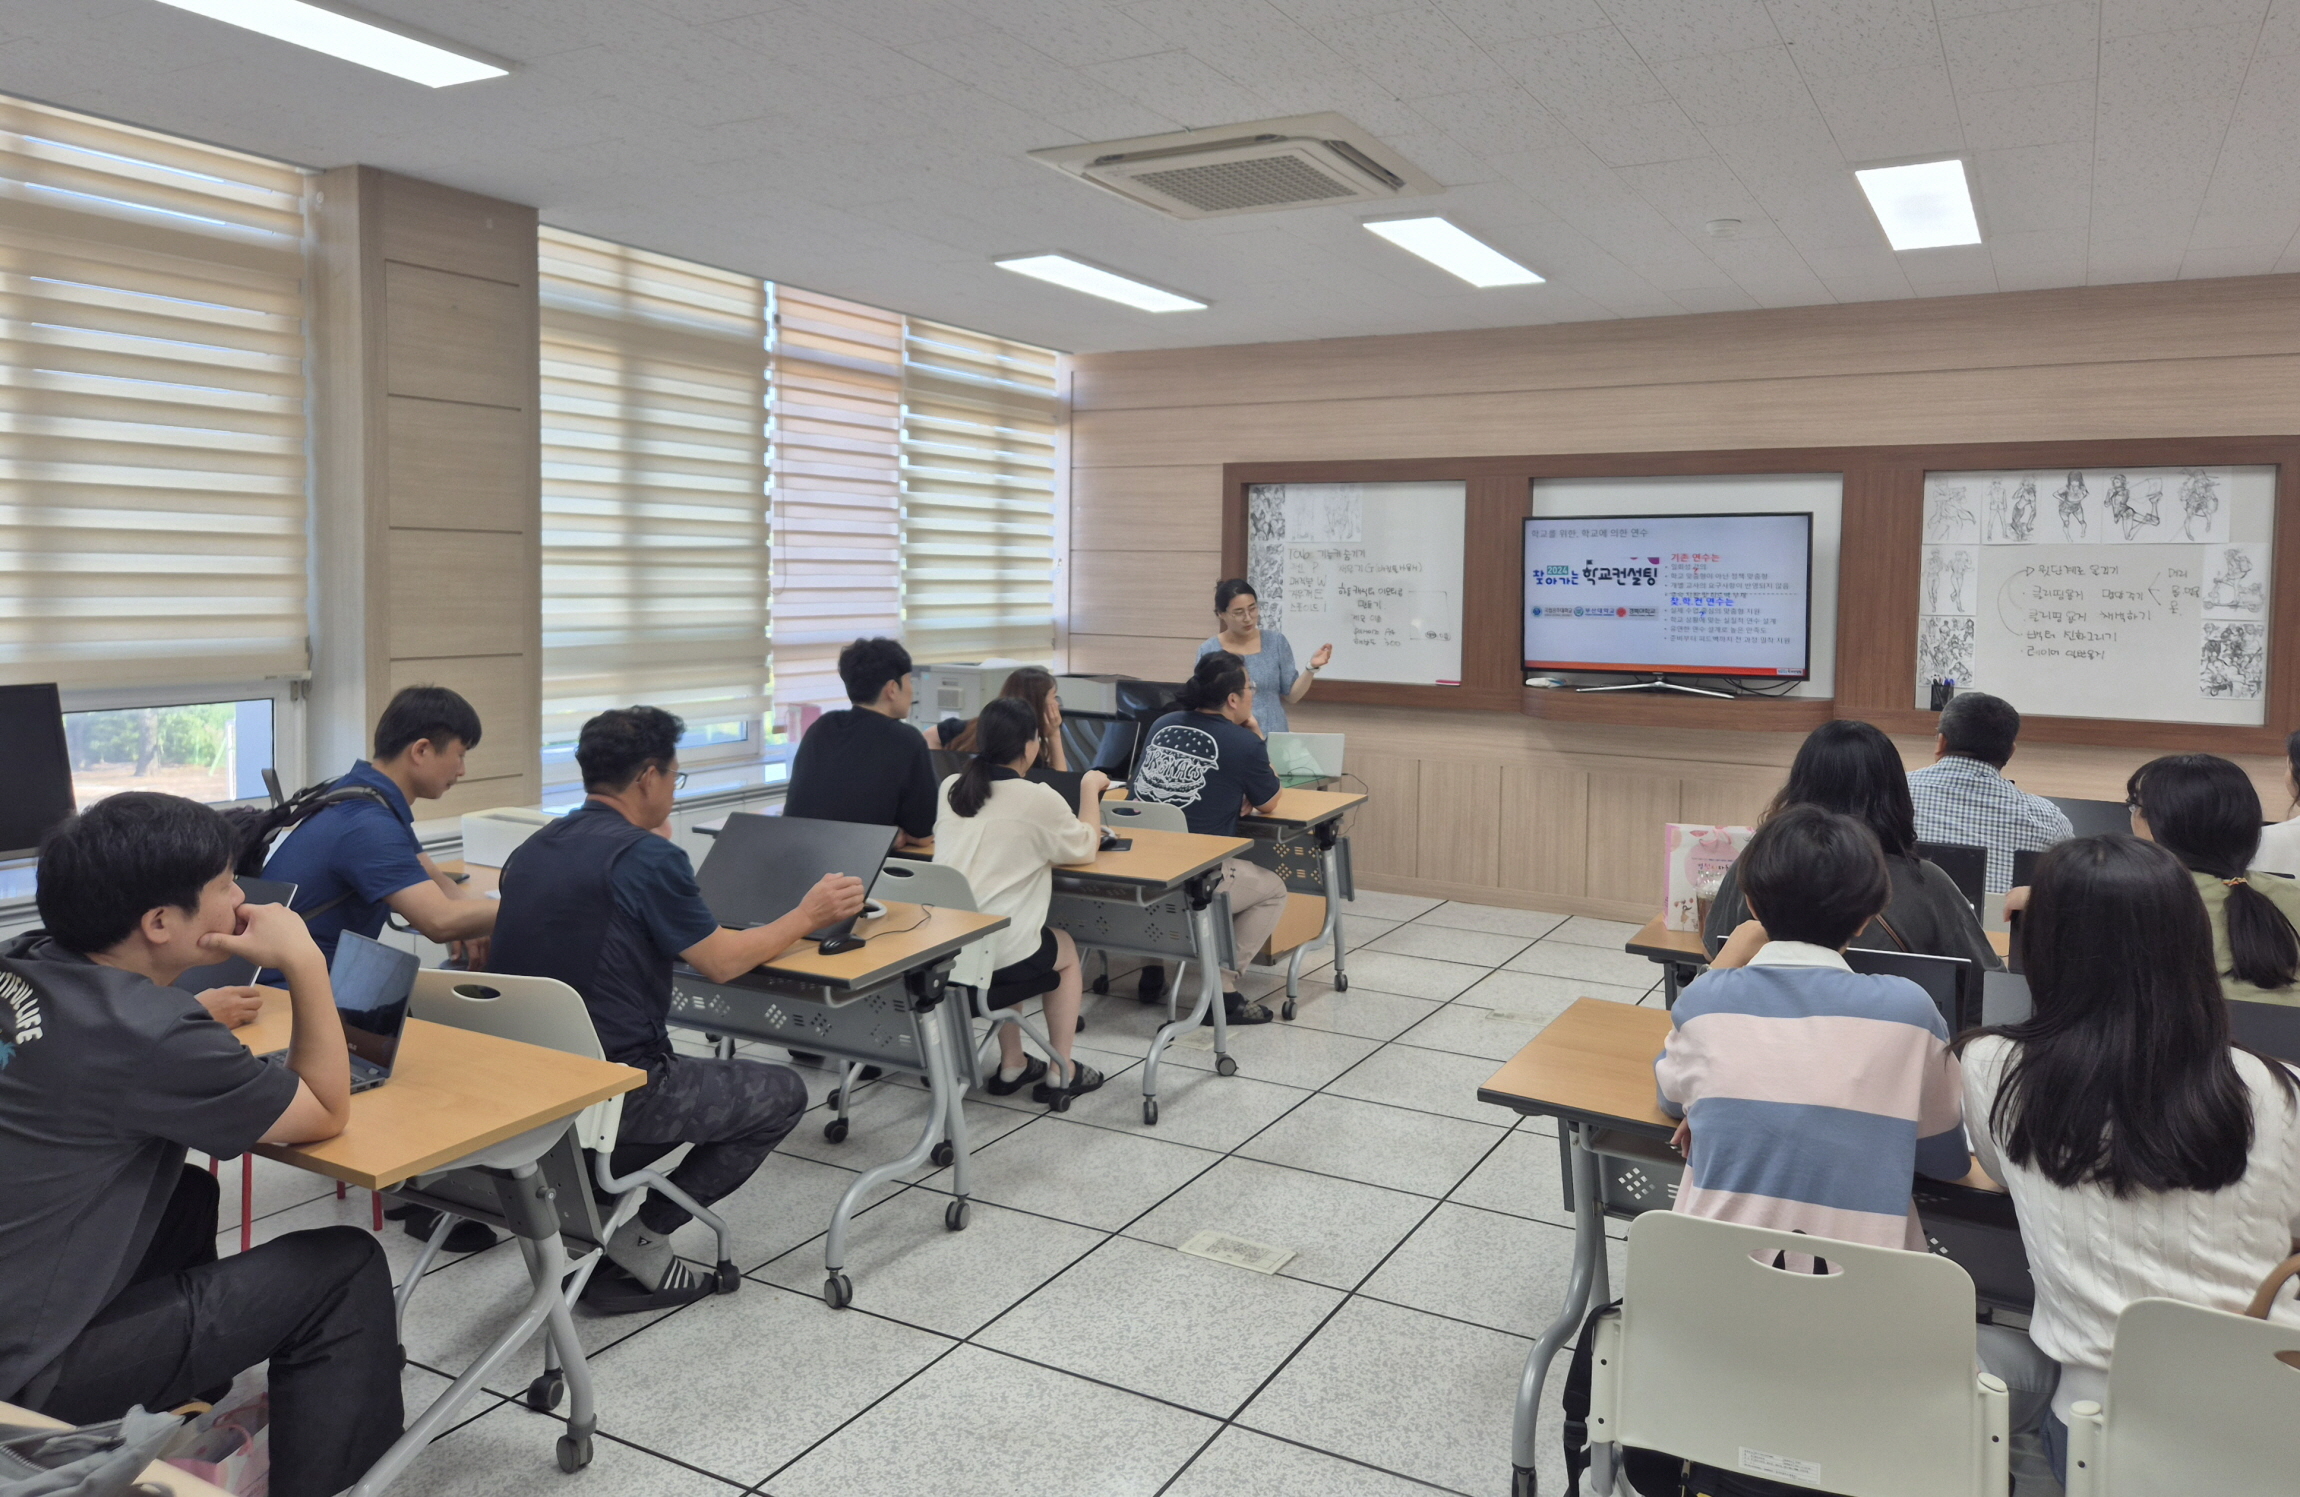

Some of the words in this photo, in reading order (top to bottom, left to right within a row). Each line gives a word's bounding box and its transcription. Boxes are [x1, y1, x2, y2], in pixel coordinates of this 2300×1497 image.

[1531, 529, 1556, 539] 학교를
[1581, 528, 1608, 538] 학교에
[1610, 528, 1628, 538] 의한
[1630, 528, 1649, 538] 연수
[1671, 553, 1689, 562] 기존
[1691, 553, 1721, 562] 연수는
[1533, 569, 1579, 585] 찾아가는
[1582, 563, 1658, 586] 학교컨설팅
[1547, 566, 1569, 575] 2024
[1706, 596, 1735, 607] 연수는
